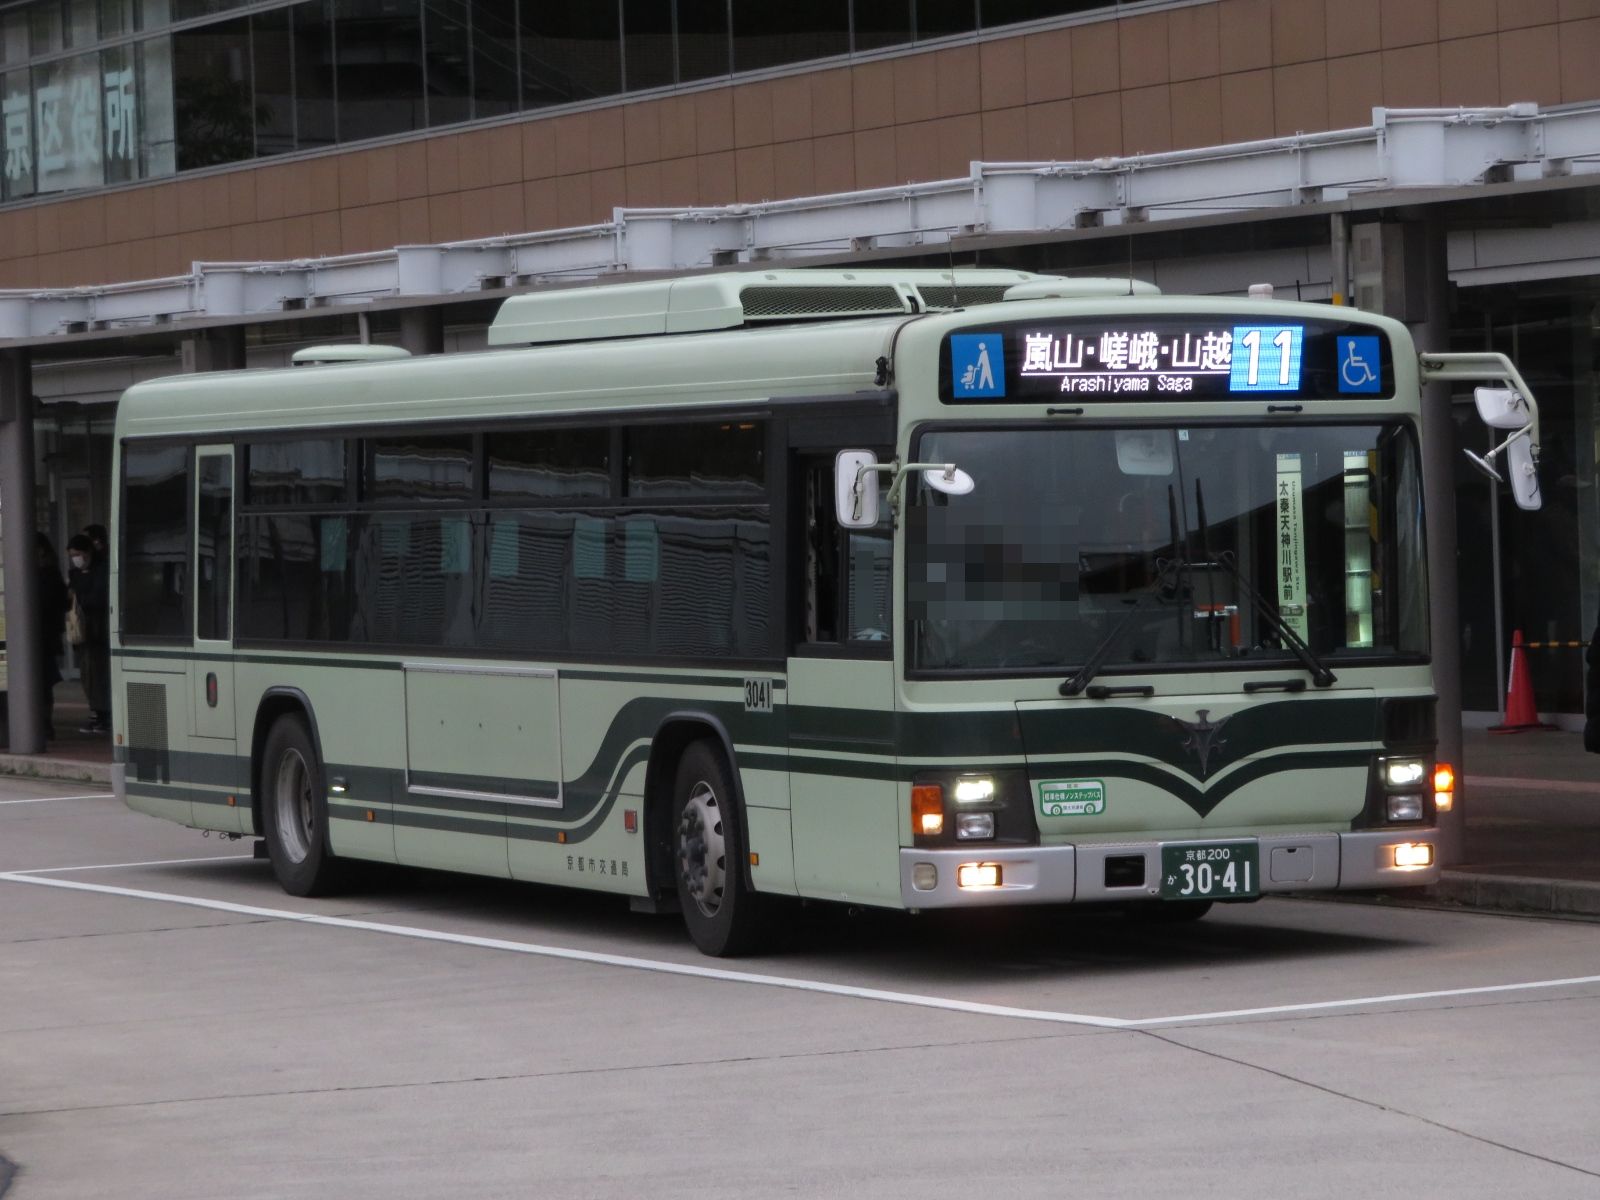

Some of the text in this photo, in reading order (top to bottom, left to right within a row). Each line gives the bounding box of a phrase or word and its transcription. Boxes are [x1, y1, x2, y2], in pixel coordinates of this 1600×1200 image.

[1022, 331, 1232, 372] 嵐山・嵯峨・山越
[1241, 329, 1293, 386] 11
[1060, 375, 1193, 392] Arashiyama Saga
[1279, 480, 1293, 601] 太秦天神川駅前
[745, 680, 770, 709] 3041
[1185, 848, 1230, 861] 京都 200
[1167, 861, 1251, 895] か 30-41
